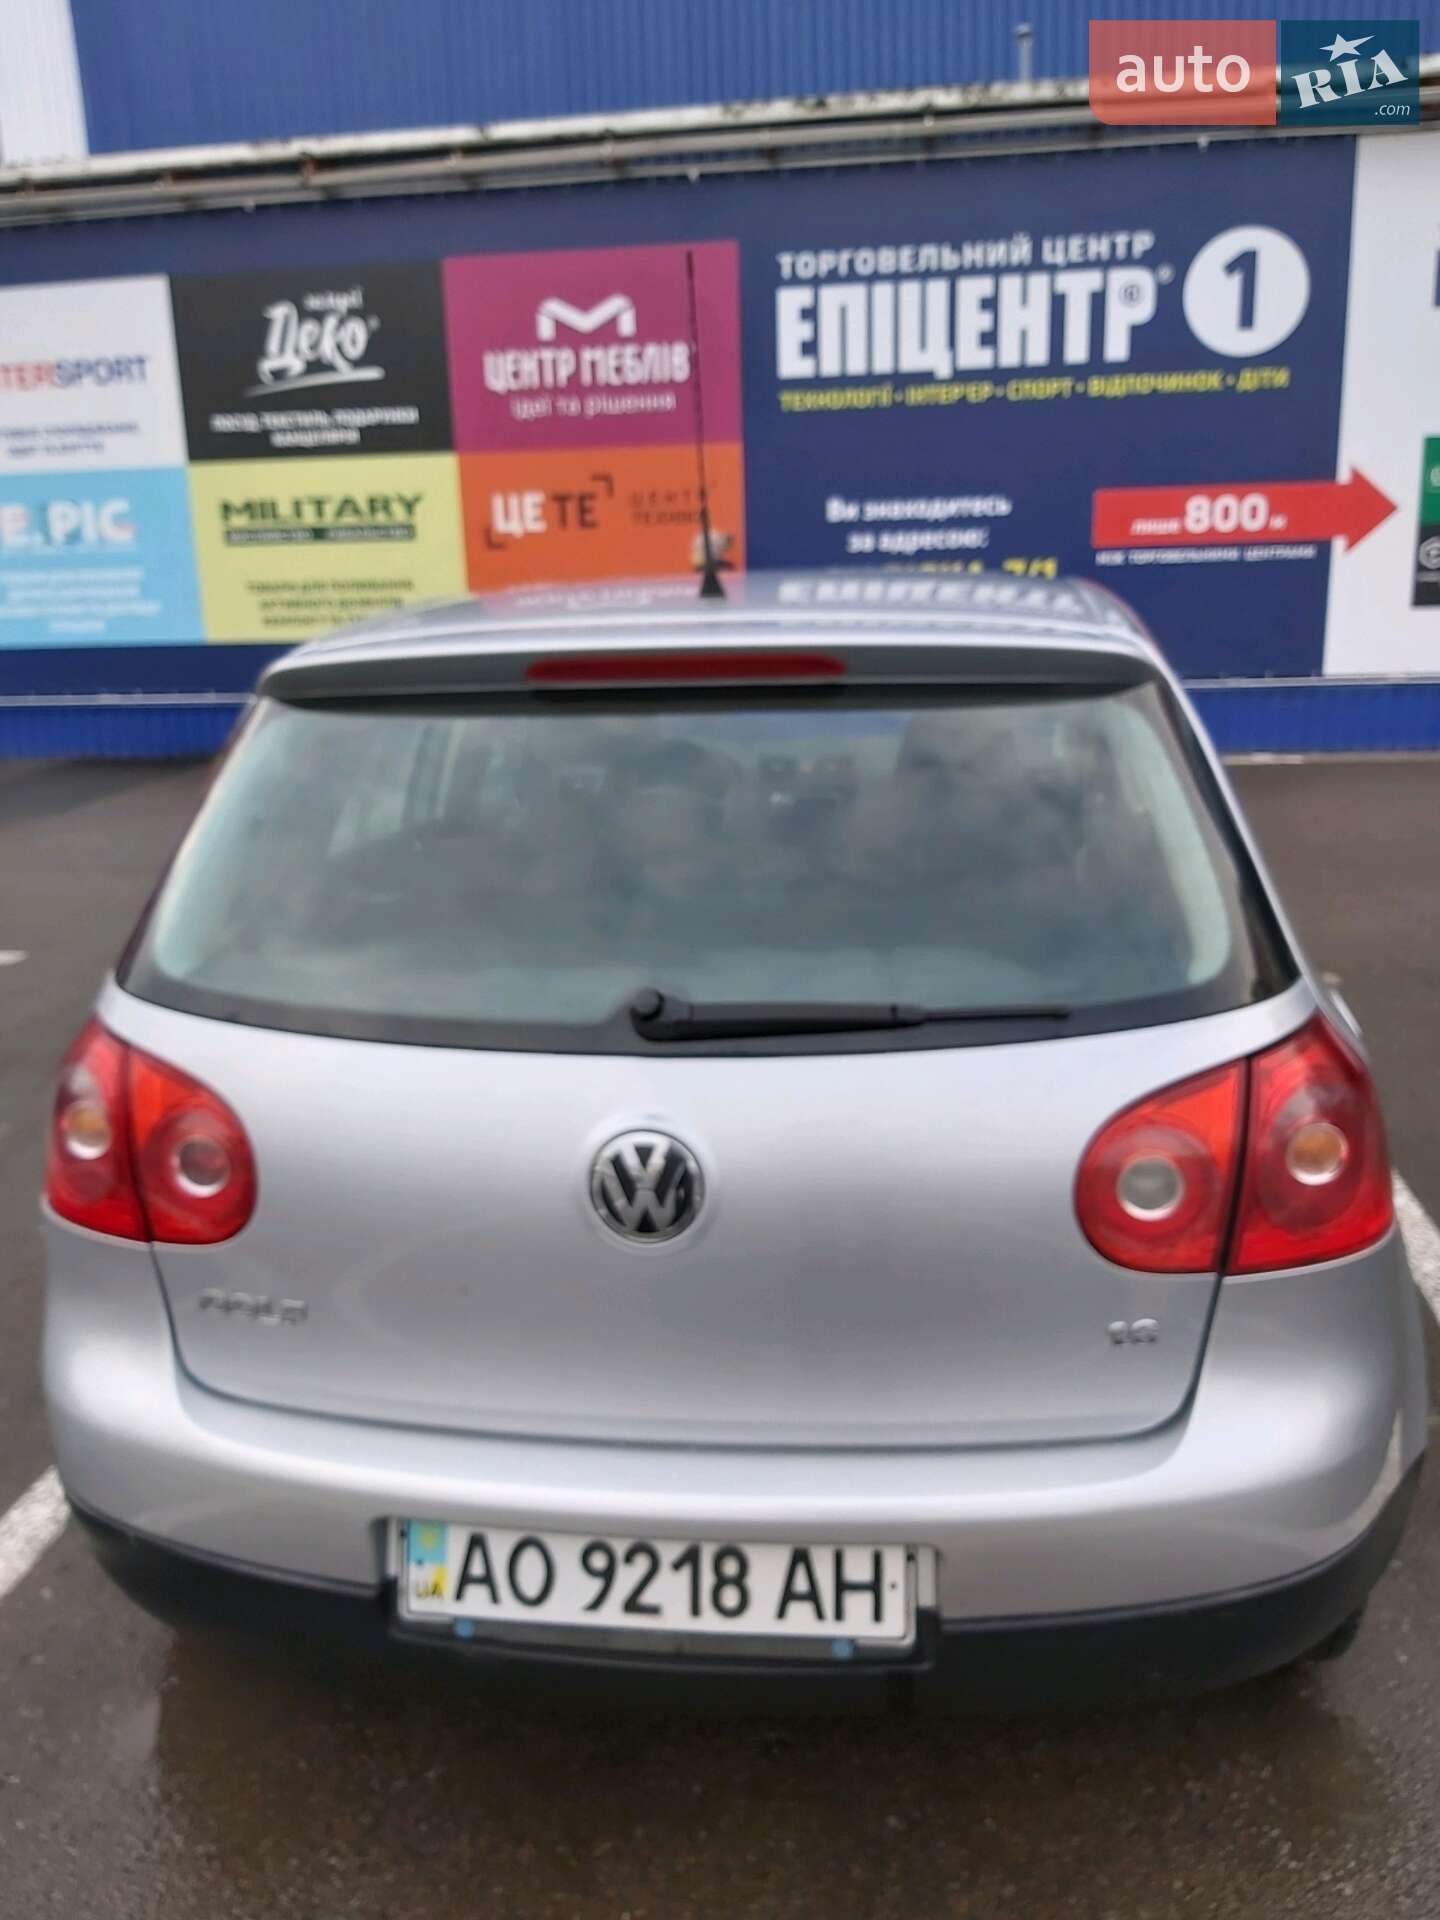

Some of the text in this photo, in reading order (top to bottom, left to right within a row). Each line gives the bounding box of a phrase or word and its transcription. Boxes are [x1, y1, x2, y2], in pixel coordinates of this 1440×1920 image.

[776, 230, 1156, 280] ТОРГОВЕЛЬНИЙ ЦЕНТР
[775, 266, 1158, 380] ЕПІЦЕНТР
[483, 341, 691, 394] ЦЕНТР МЕБЛІВ
[221, 492, 423, 522] MILITARY
[1184, 493, 1270, 535] 800
[581, 1540, 751, 1618] 9218
